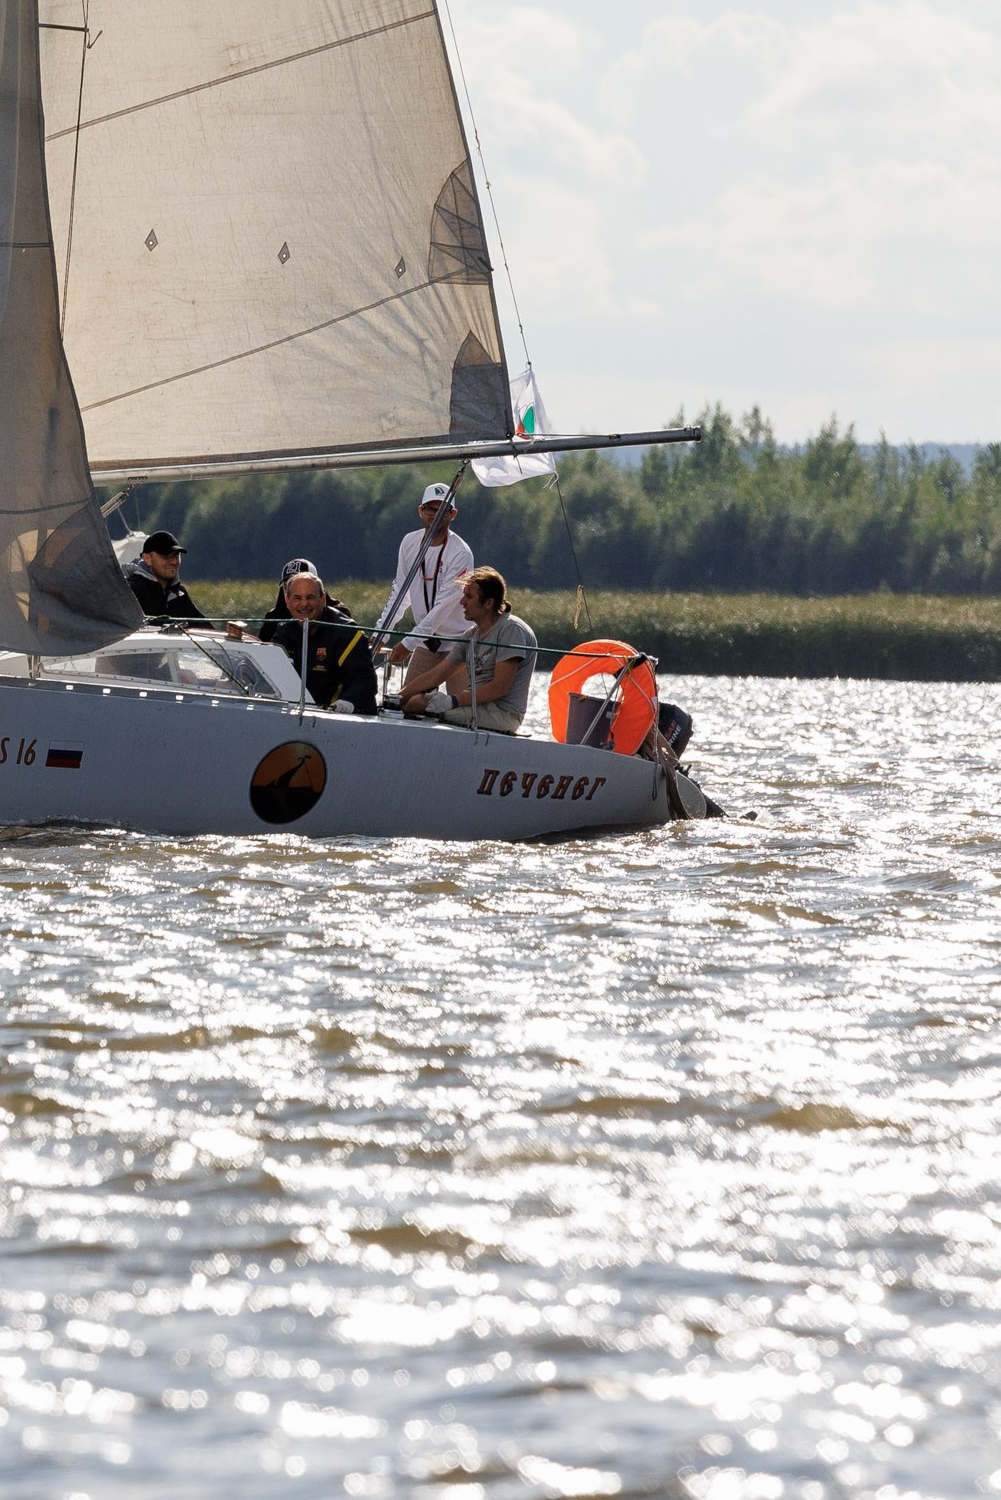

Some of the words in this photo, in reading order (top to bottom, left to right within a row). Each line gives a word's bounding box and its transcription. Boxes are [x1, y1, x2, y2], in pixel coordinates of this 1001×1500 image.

[286, 561, 301, 574] 21
[668, 724, 682, 746] RINE
[16, 738, 37, 766] 16
